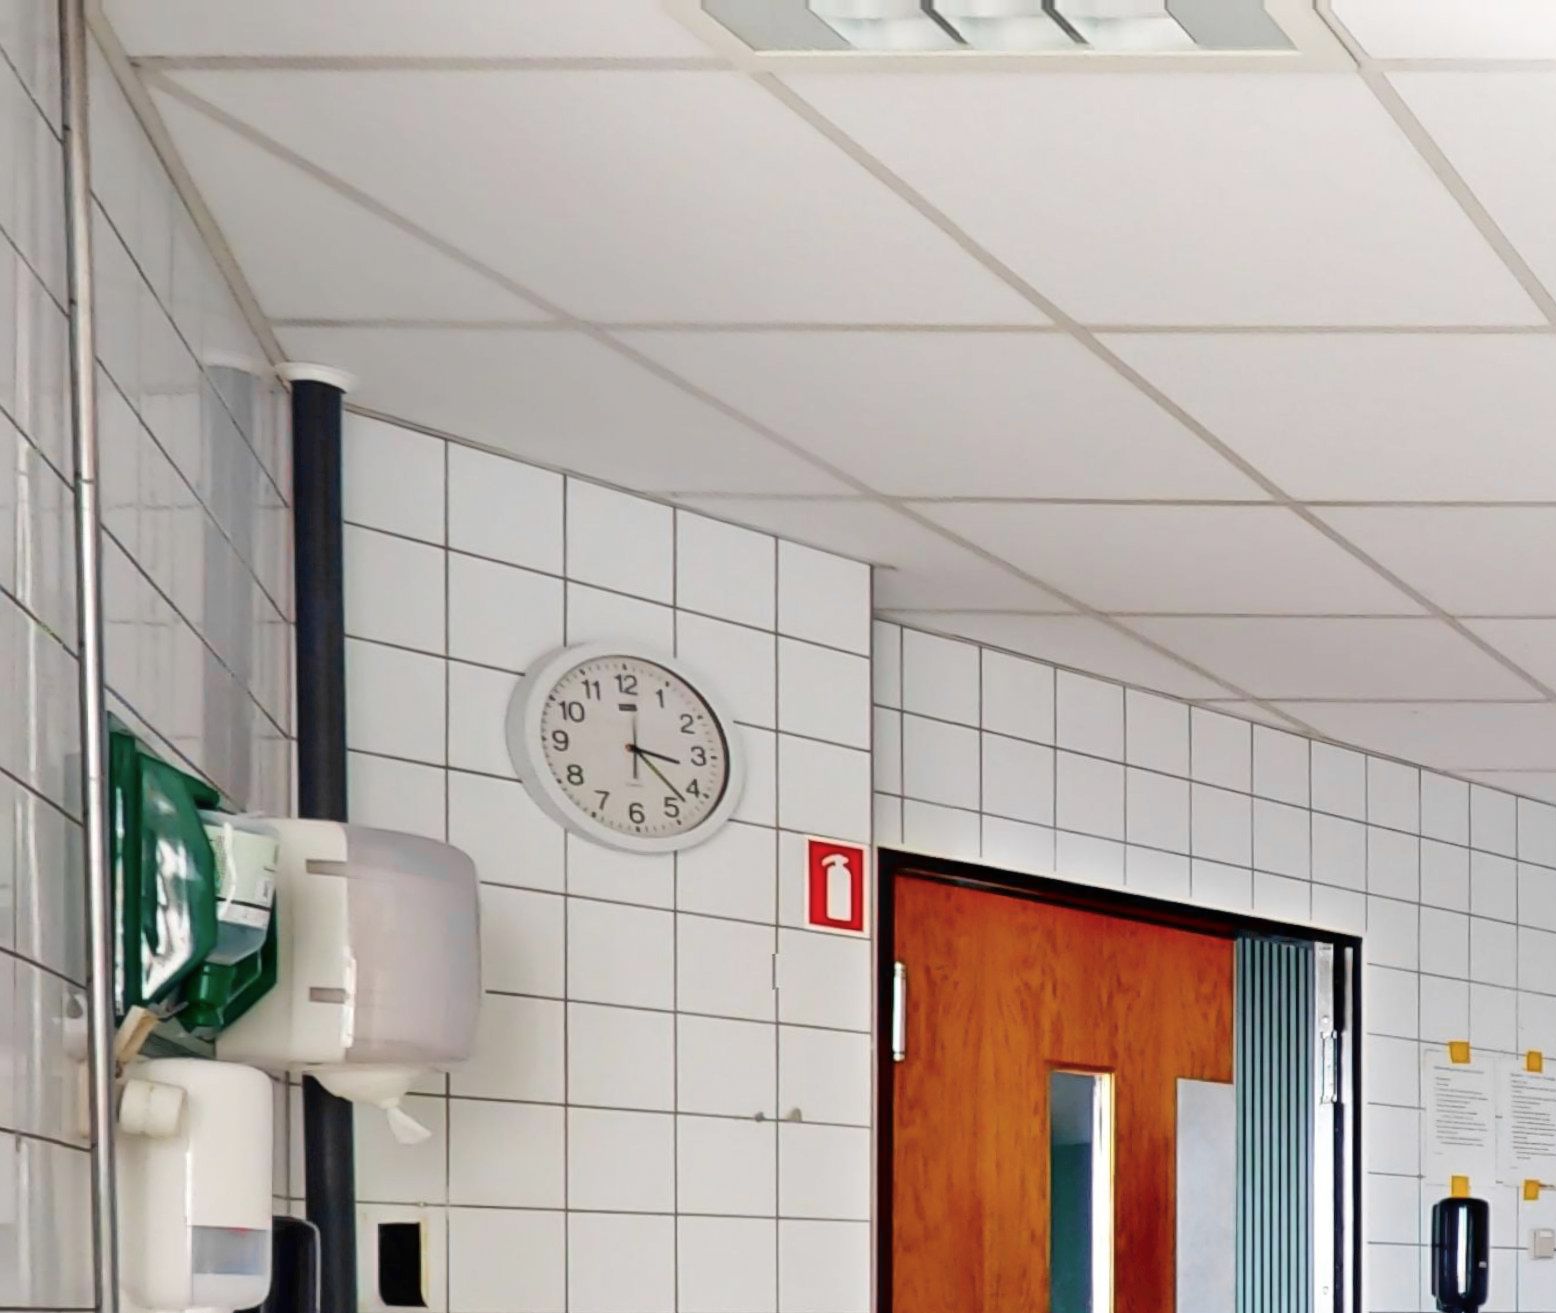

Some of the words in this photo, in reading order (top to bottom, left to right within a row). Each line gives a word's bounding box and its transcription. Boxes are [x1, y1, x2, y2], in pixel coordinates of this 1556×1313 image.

[581, 680, 601, 700] 11
[614, 674, 638, 696] 12
[656, 688, 664, 708] 1
[559, 701, 585, 723] 10
[680, 714, 695, 735] 2
[552, 730, 569, 751] 9
[690, 746, 707, 767] 3
[567, 764, 584, 786] 8
[686, 778, 699, 798] 4
[594, 790, 610, 810] 7
[663, 796, 680, 818] 5
[629, 802, 645, 824] 6
